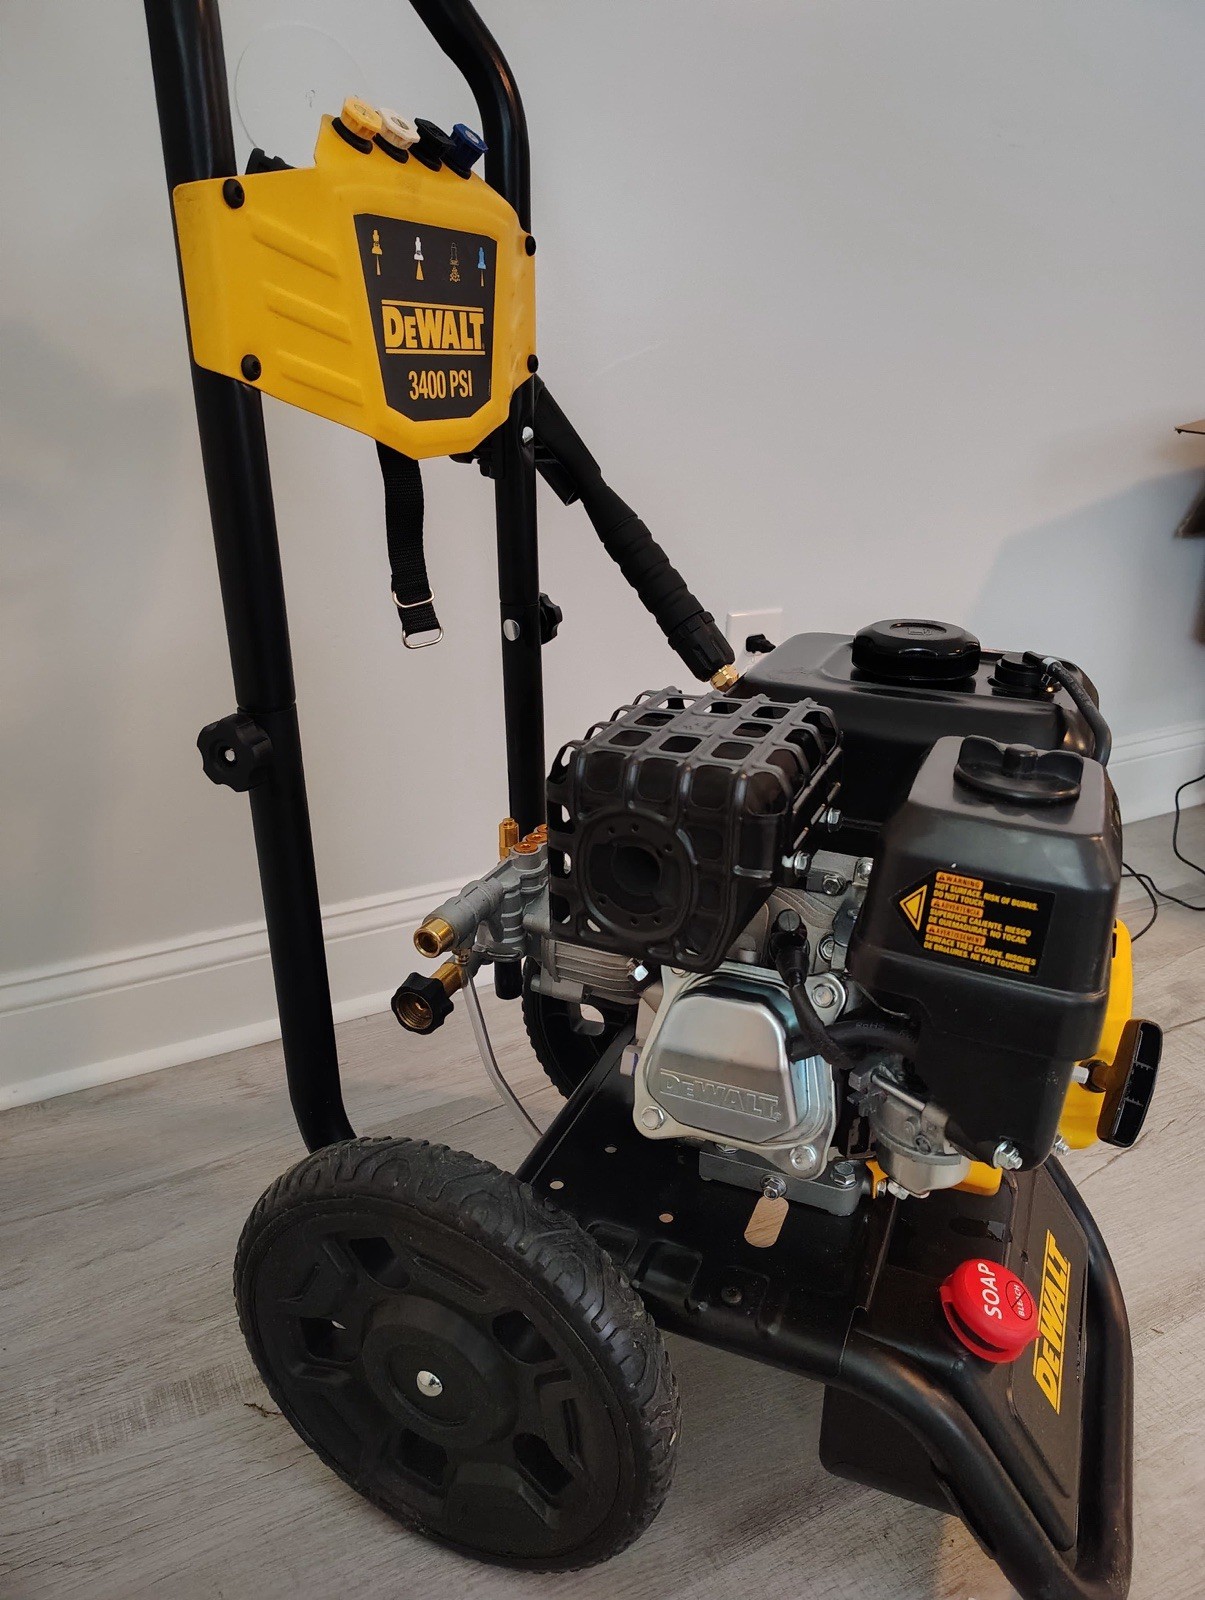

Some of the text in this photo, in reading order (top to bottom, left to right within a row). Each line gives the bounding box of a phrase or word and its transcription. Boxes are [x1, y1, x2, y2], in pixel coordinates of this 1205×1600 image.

[408, 370, 447, 400] 3400
[449, 369, 473, 398] PSI
[935, 882, 949, 892] HOT
[983, 892, 1000, 902] RISK
[1001, 896, 1011, 905] OF
[945, 876, 980, 888] WARNING
[933, 889, 985, 907] DO NOT TOUCH.
[940, 903, 980, 916] ADVERTENCIA
[928, 916, 938, 924] DE
[990, 930, 1001, 939] NO
[930, 908, 968, 923] SUPERFICIE
[1005, 925, 1032, 937] RIESGO
[935, 929, 983, 944] AVERTISSEMENT
[924, 942, 933, 950] DE
[970, 952, 980, 960] NE
[981, 955, 996, 965] PAS
[925, 934, 955, 947] SURFACE
[1005, 953, 1036, 966] RISQUES
[977, 1262, 1003, 1320] SOAP
